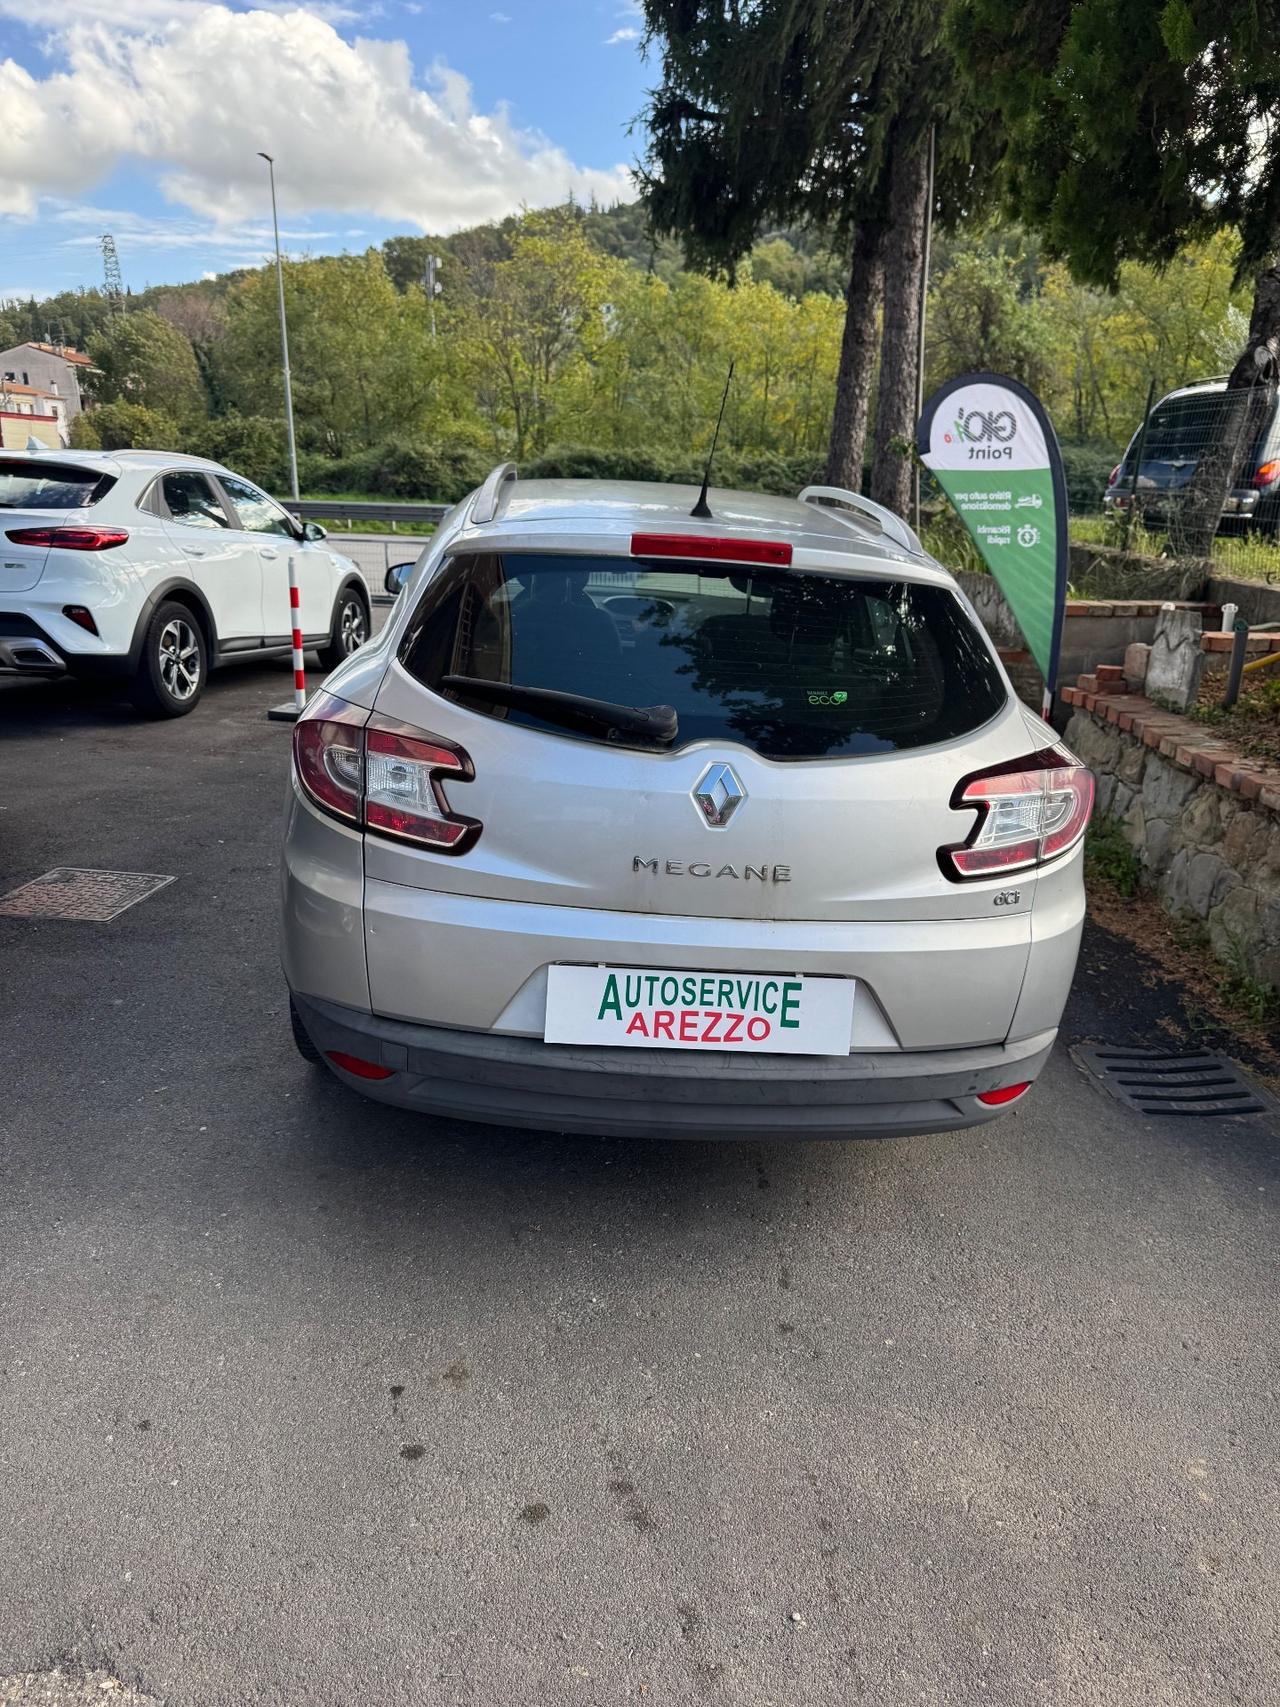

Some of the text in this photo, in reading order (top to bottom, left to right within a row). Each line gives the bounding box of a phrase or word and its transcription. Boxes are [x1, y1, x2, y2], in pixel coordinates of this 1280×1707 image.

[632, 855, 792, 882] MEGANE
[993, 889, 1020, 906] dCi
[597, 973, 803, 1029] AUTOSERVICE
[626, 1010, 771, 1043] AREZZO
